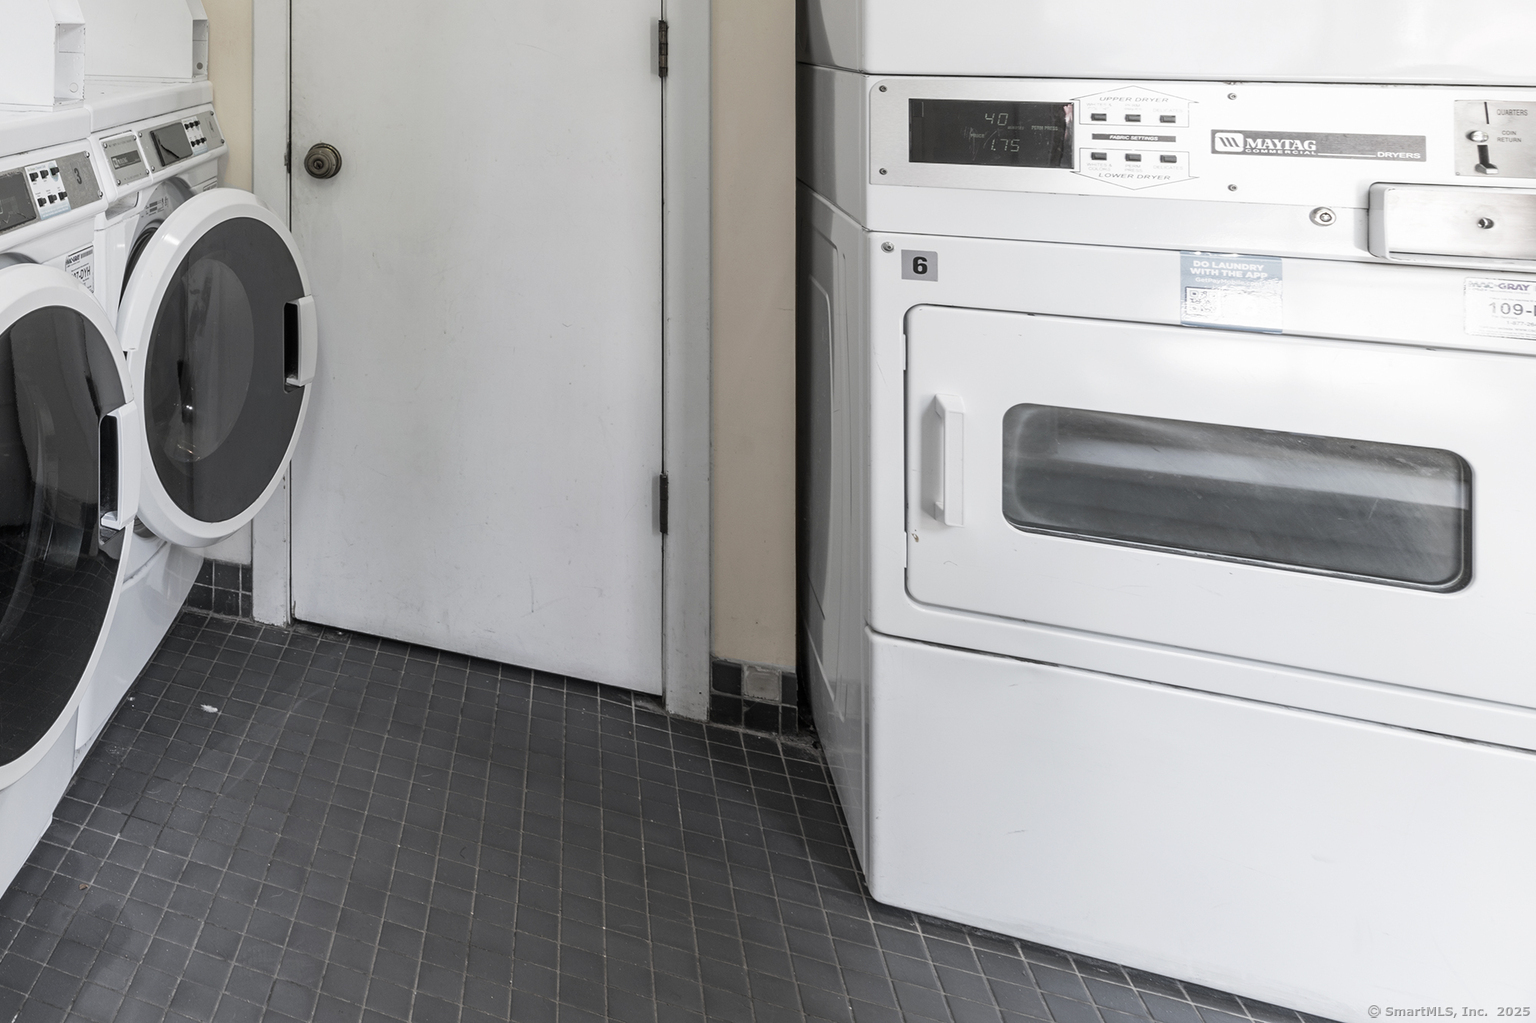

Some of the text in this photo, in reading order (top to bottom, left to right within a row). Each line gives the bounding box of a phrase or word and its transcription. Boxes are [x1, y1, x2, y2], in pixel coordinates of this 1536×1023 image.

[1245, 138, 1316, 151] MAYTAG
[74, 168, 82, 184] 3
[912, 256, 928, 276] 6
[1190, 267, 1219, 276] WITH
[1212, 261, 1264, 271] LAUNDRY
[1489, 302, 1536, 316] 109-
